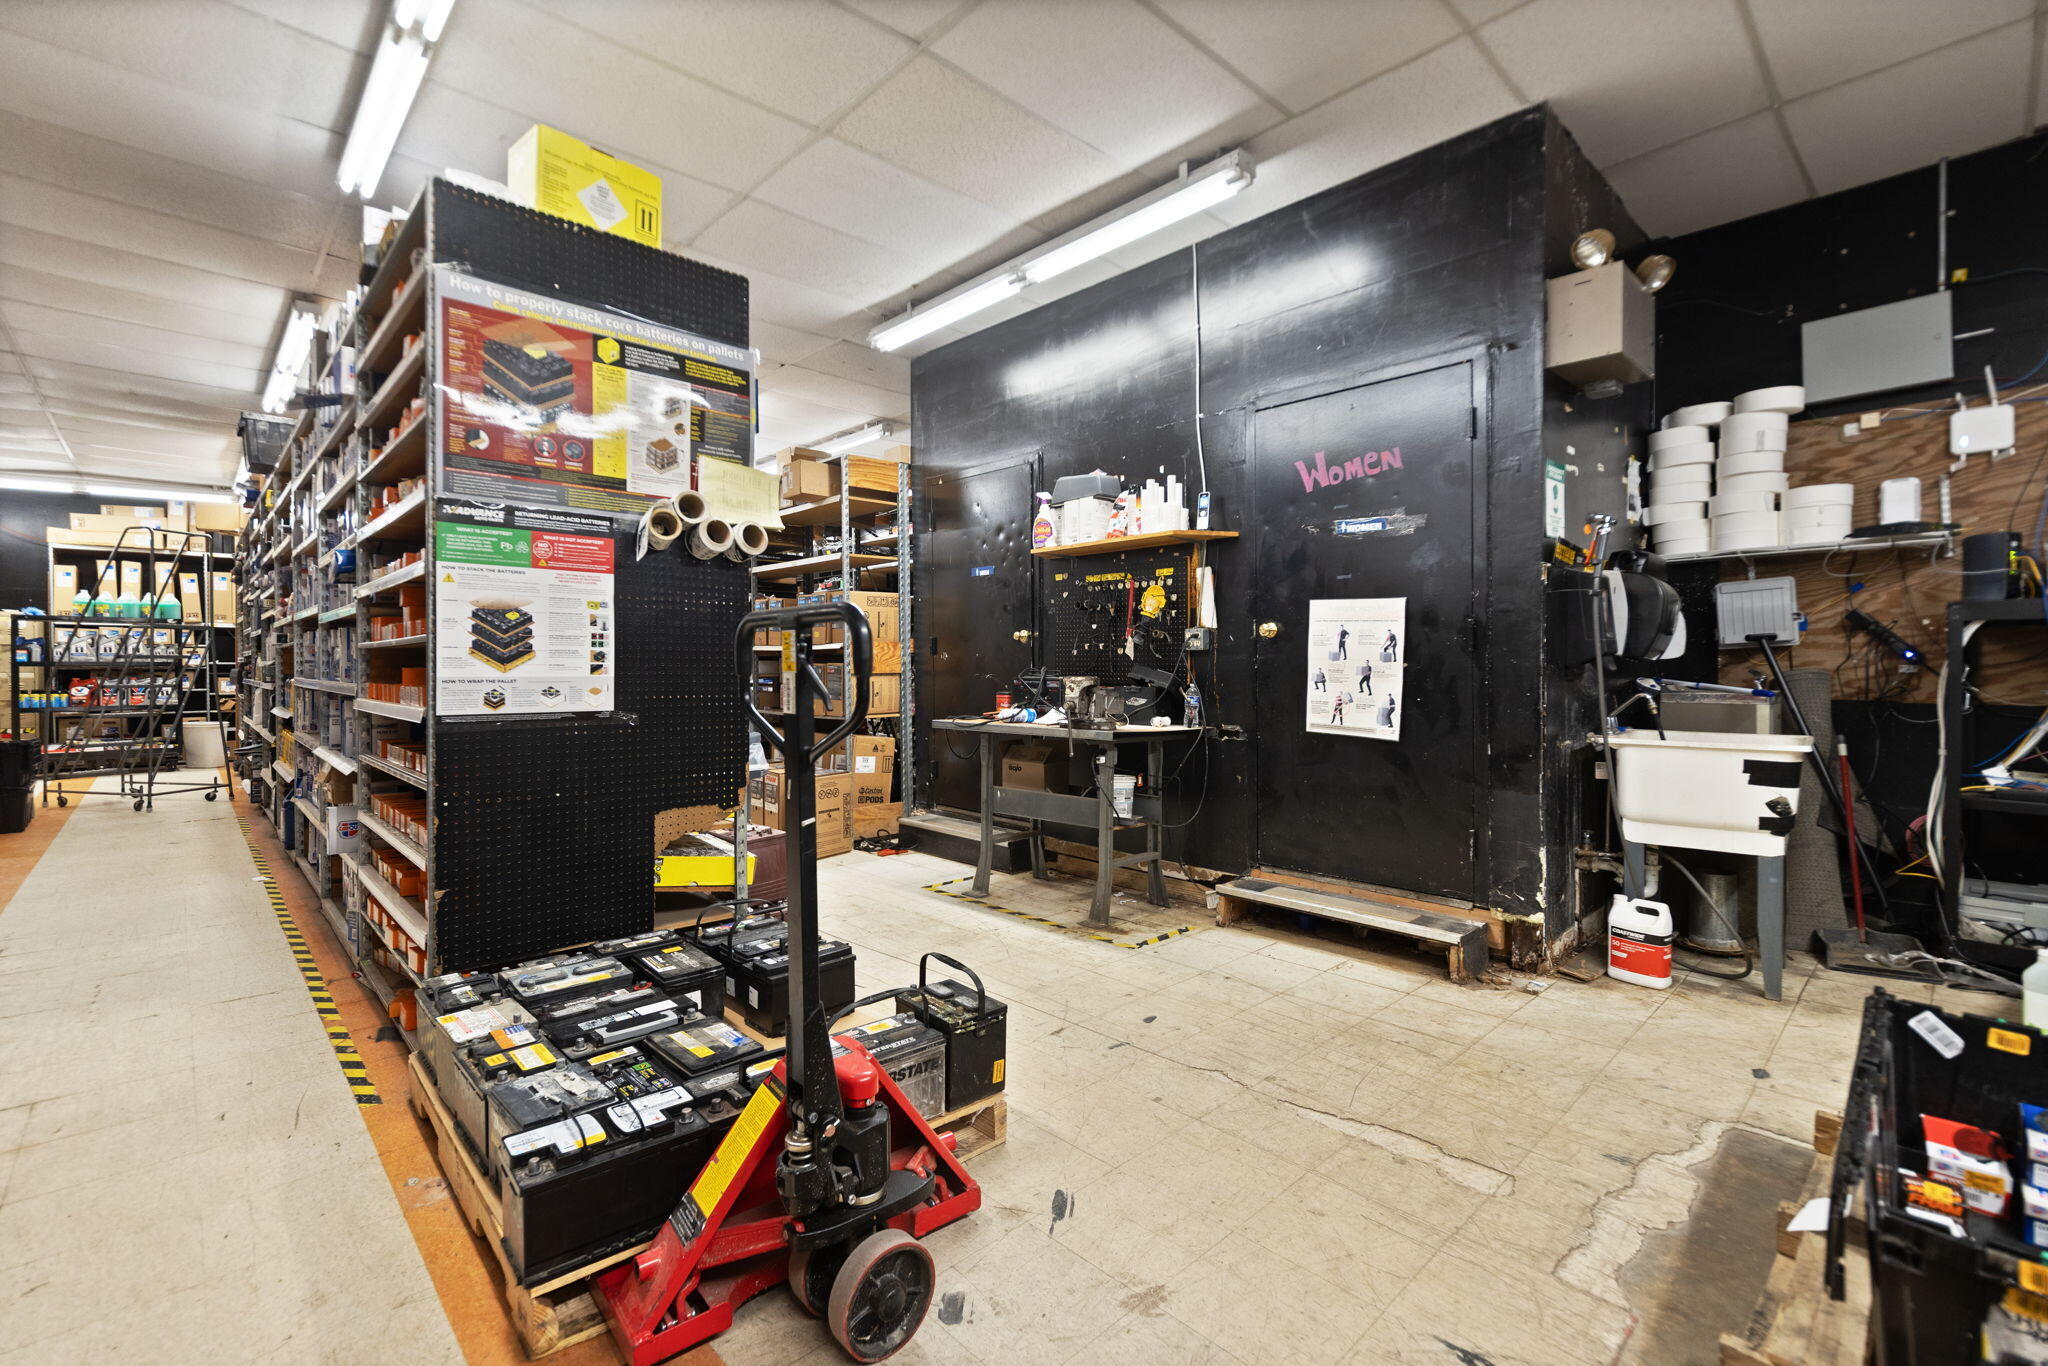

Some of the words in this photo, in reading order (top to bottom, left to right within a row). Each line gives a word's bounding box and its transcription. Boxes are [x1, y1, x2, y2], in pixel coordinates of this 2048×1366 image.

[450, 275, 482, 295] How
[487, 286, 501, 299] to
[505, 291, 563, 316] properly
[566, 307, 602, 324] stack
[606, 319, 632, 334] core
[636, 324, 689, 347] batteries
[691, 339, 706, 351] on
[708, 344, 744, 361] pallets
[454, 506, 504, 519] ADVANCE
[865, 796, 884, 804] PODS
